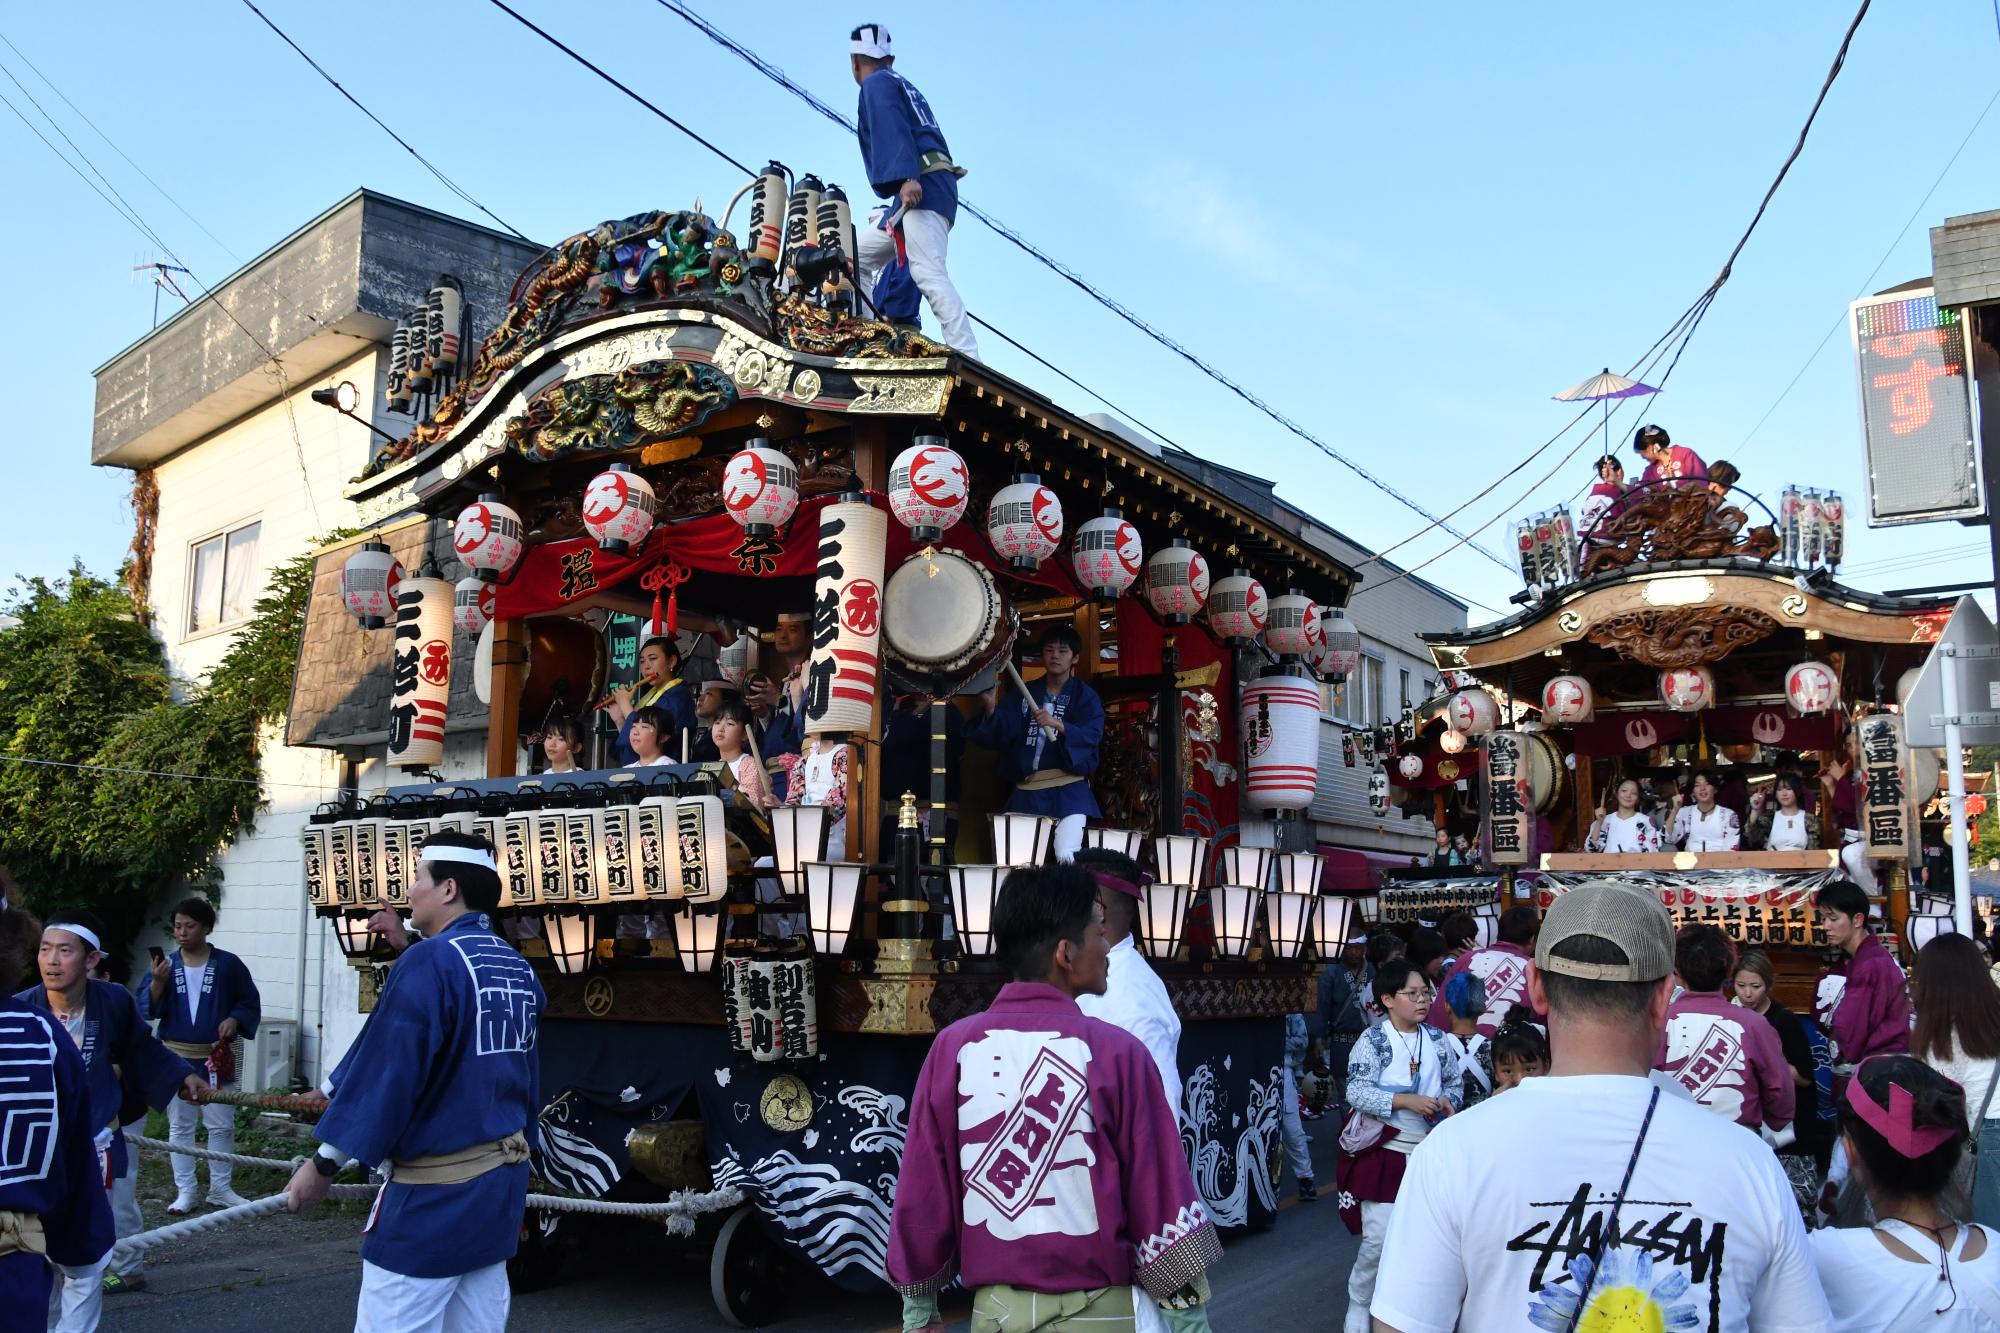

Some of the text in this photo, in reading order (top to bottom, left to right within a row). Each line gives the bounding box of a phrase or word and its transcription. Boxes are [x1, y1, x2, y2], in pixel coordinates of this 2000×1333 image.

[1680, 906, 1699, 922] 上
[1745, 905, 1764, 942] 上町
[1767, 907, 1787, 942] 上町
[1787, 907, 1806, 942] 上町
[174, 967, 187, 994] 三杉町
[201, 966, 216, 994] 三杉町
[81, 1036, 97, 1071] 三杉
[985, 1072, 1066, 1200] 上町区
